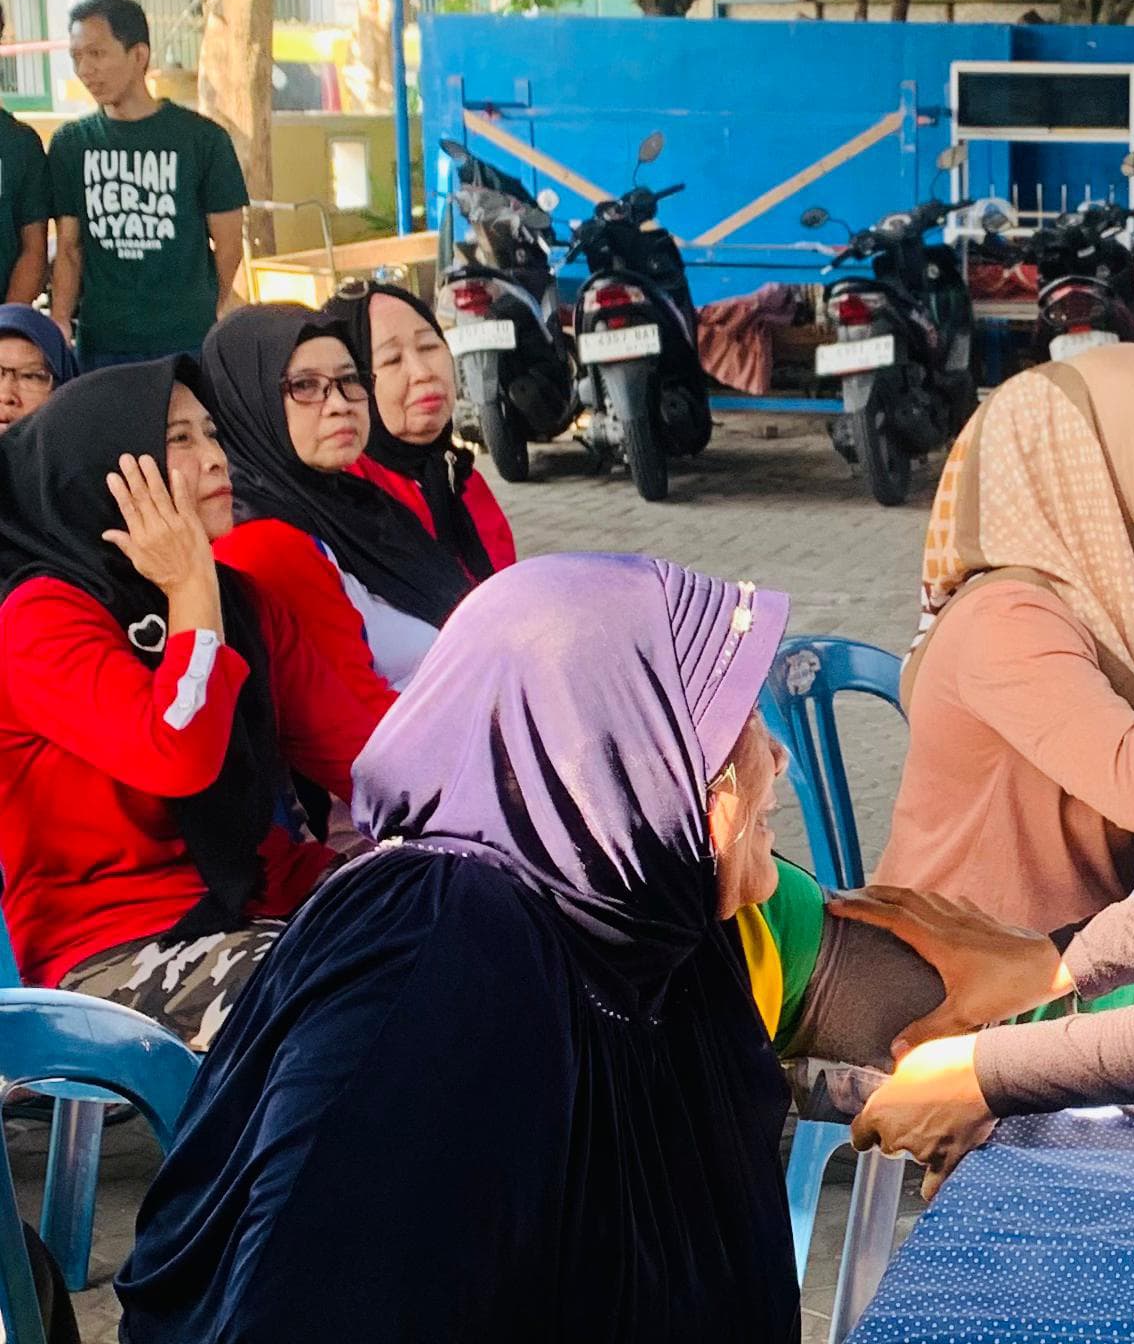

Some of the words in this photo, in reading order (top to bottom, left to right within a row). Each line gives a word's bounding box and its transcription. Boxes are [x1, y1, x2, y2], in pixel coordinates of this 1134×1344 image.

[84, 149, 177, 193] KULIAH
[85, 181, 176, 220] KERJA
[89, 212, 175, 240] NYATA
